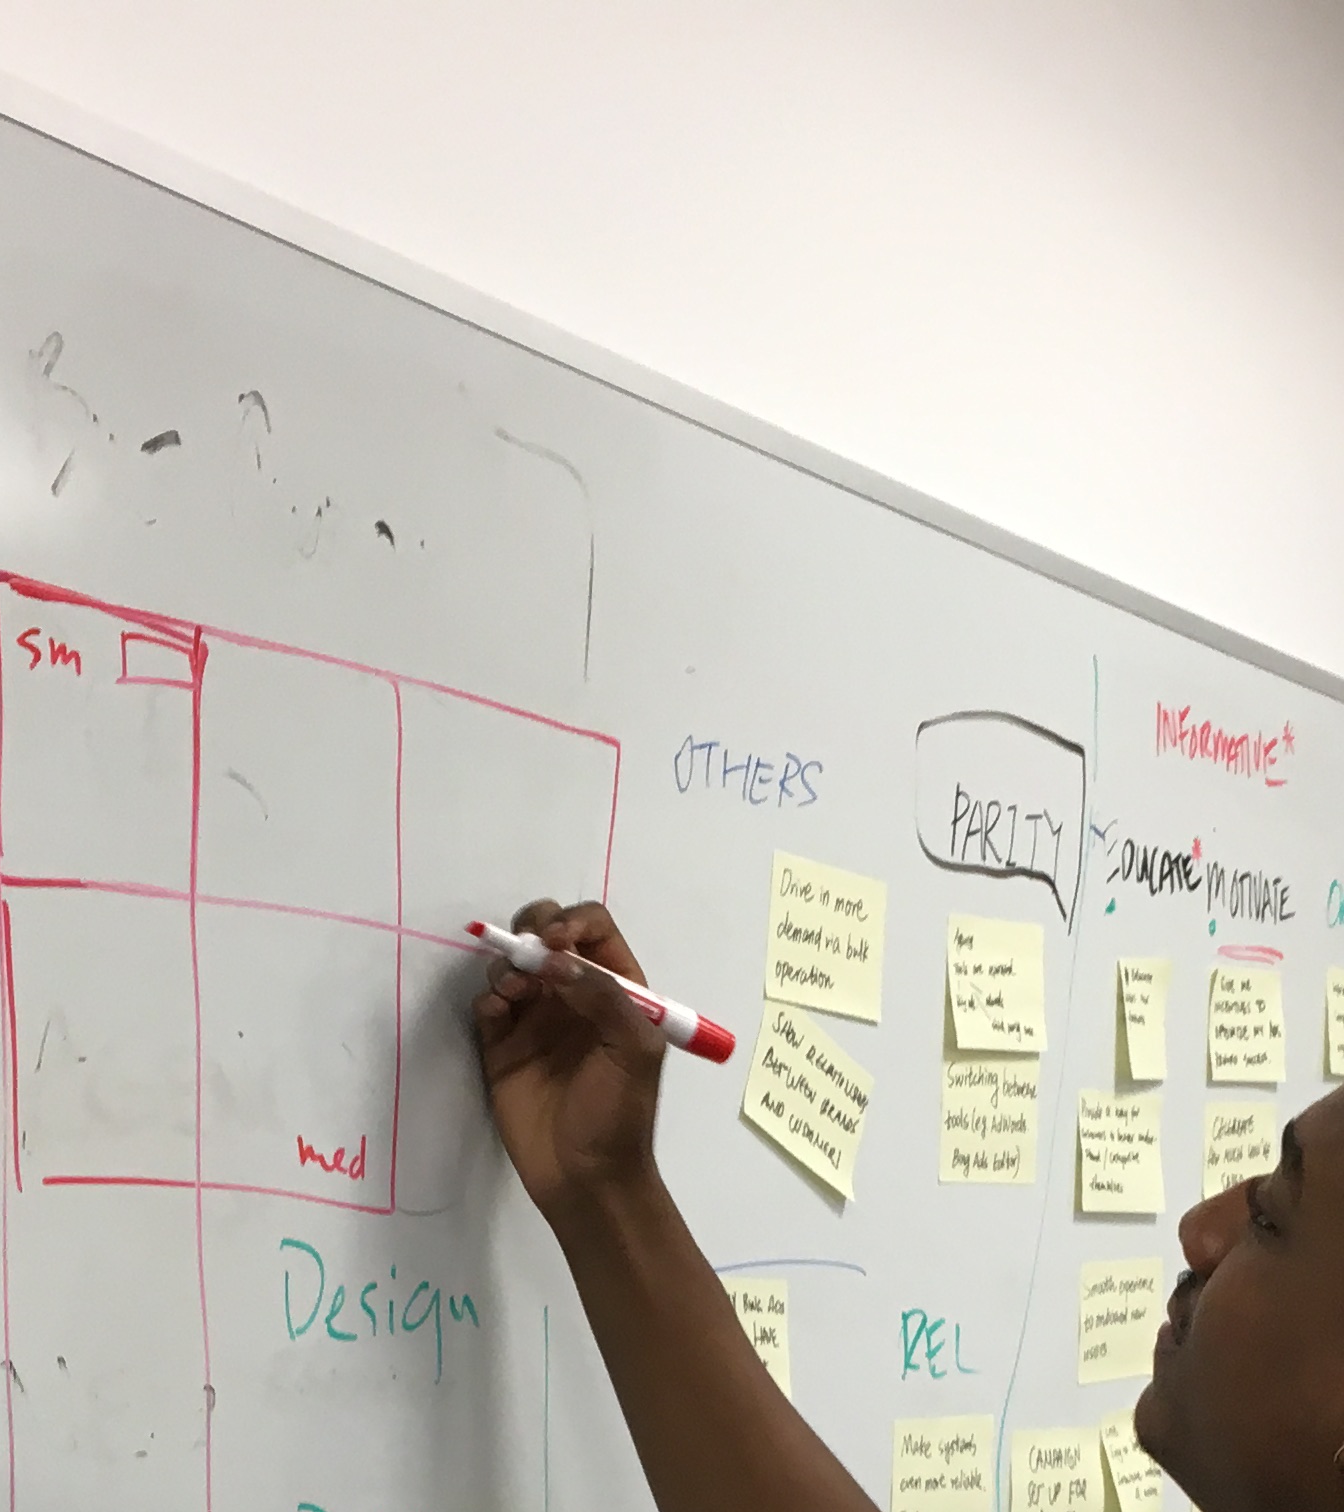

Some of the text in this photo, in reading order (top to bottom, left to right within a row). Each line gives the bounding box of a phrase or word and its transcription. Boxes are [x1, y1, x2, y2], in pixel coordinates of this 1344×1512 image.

[674, 734, 824, 808] OTHERS
[950, 783, 1064, 876] PARITY
[779, 868, 869, 922] Drive in more
[1206, 861, 1296, 921] MOTIVATE
[777, 910, 870, 963] demand via bulk
[775, 960, 835, 990] operation
[772, 1011, 804, 1049] SHOW
[760, 1091, 785, 1118] AND
[947, 1061, 999, 1109] Switching
[820, 1098, 859, 1134] BRANDS
[944, 1107, 969, 1130] tools
[297, 1134, 367, 1179] med
[279, 1238, 480, 1385] Design
[753, 1320, 780, 1348] HAVE
[900, 1308, 979, 1380] REL
[901, 1433, 932, 1459] Make
